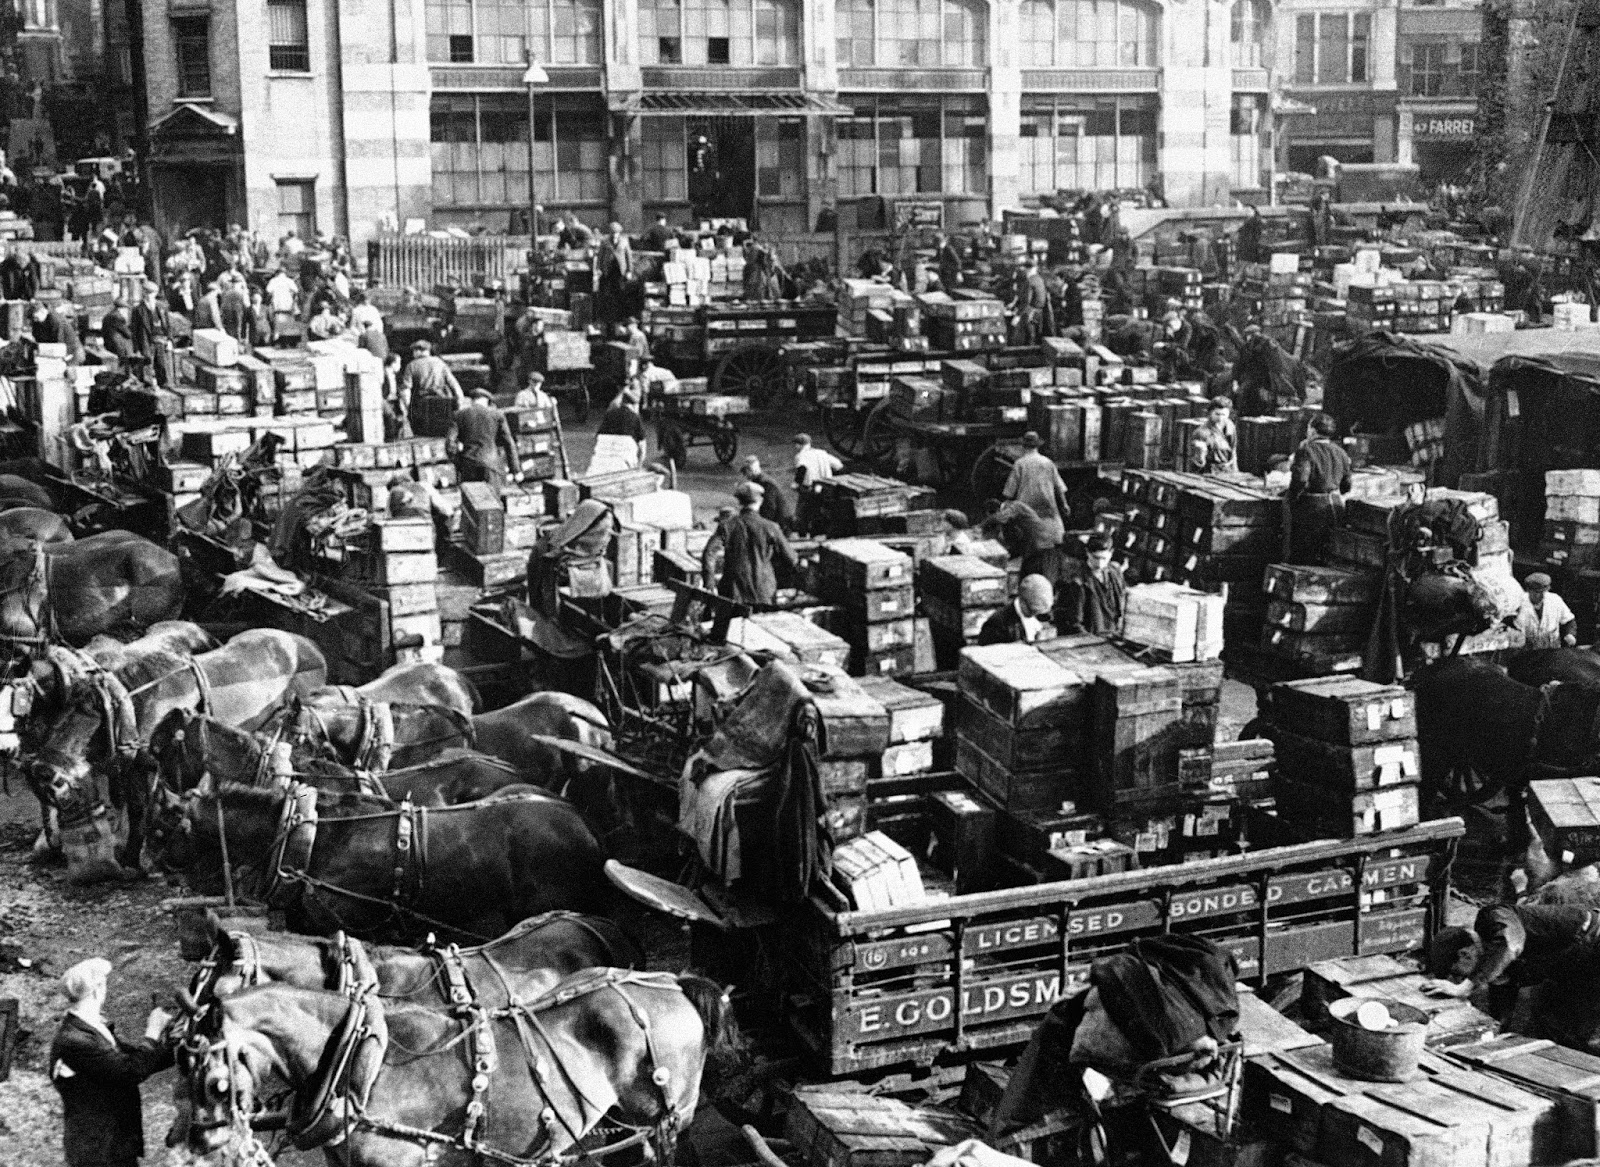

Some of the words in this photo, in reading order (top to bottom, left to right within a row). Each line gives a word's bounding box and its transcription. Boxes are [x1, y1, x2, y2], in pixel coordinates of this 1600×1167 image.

[978, 912, 1123, 948] LICENSED
[1169, 885, 1282, 917] BONDED
[1307, 863, 1415, 894] CARMEN
